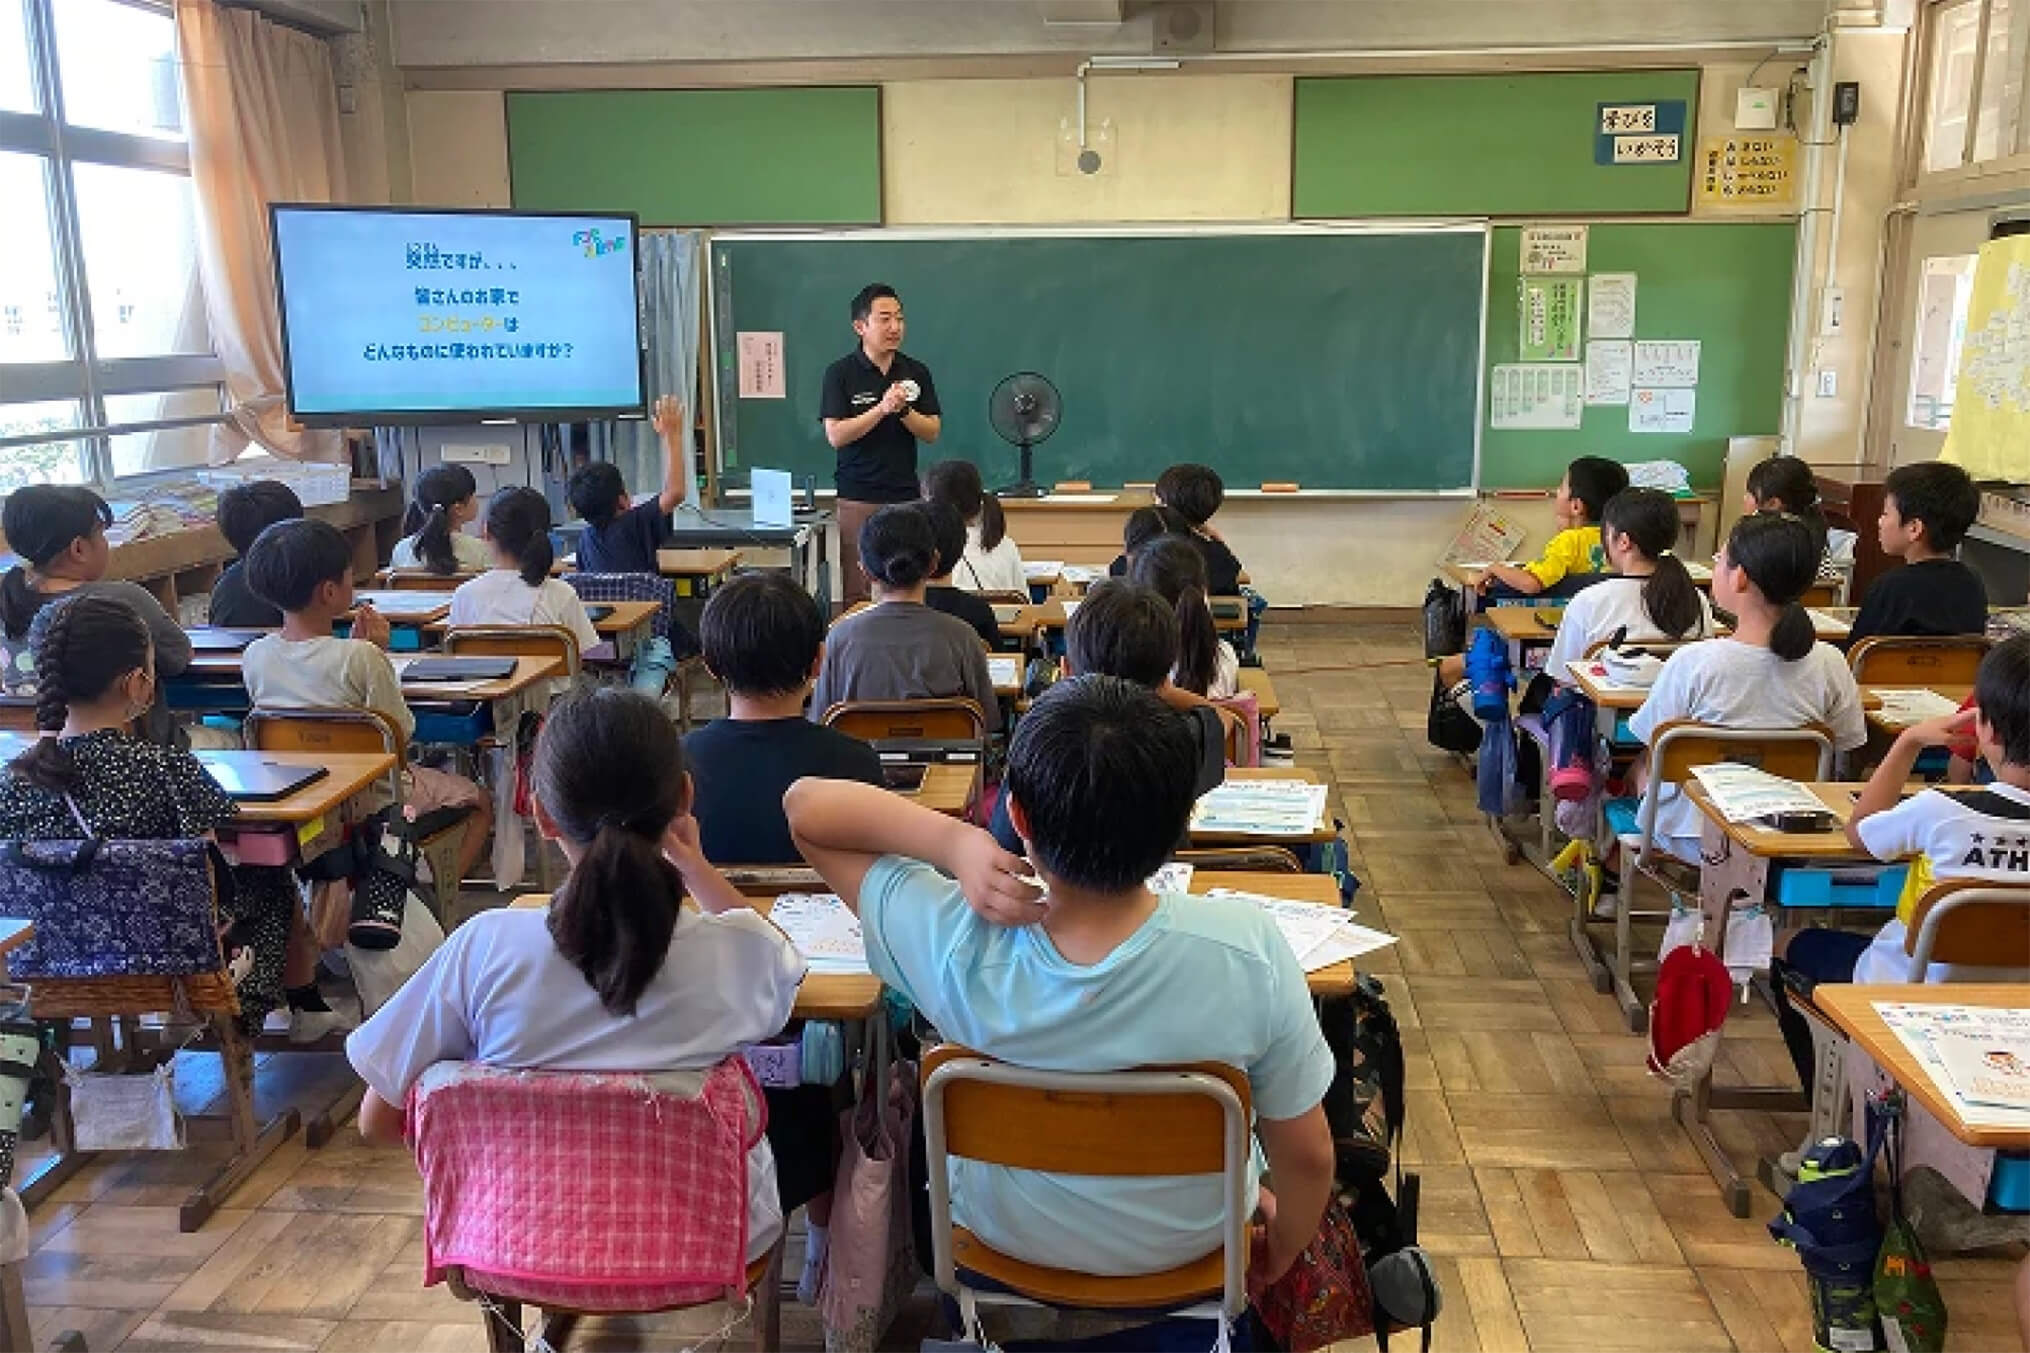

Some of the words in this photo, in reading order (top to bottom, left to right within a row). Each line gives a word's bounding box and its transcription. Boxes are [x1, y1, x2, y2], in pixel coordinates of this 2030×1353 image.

[1617, 138, 1676, 157] いかそう
[415, 285, 519, 306] 皆さんのお家で
[419, 315, 519, 332] コンピューターは
